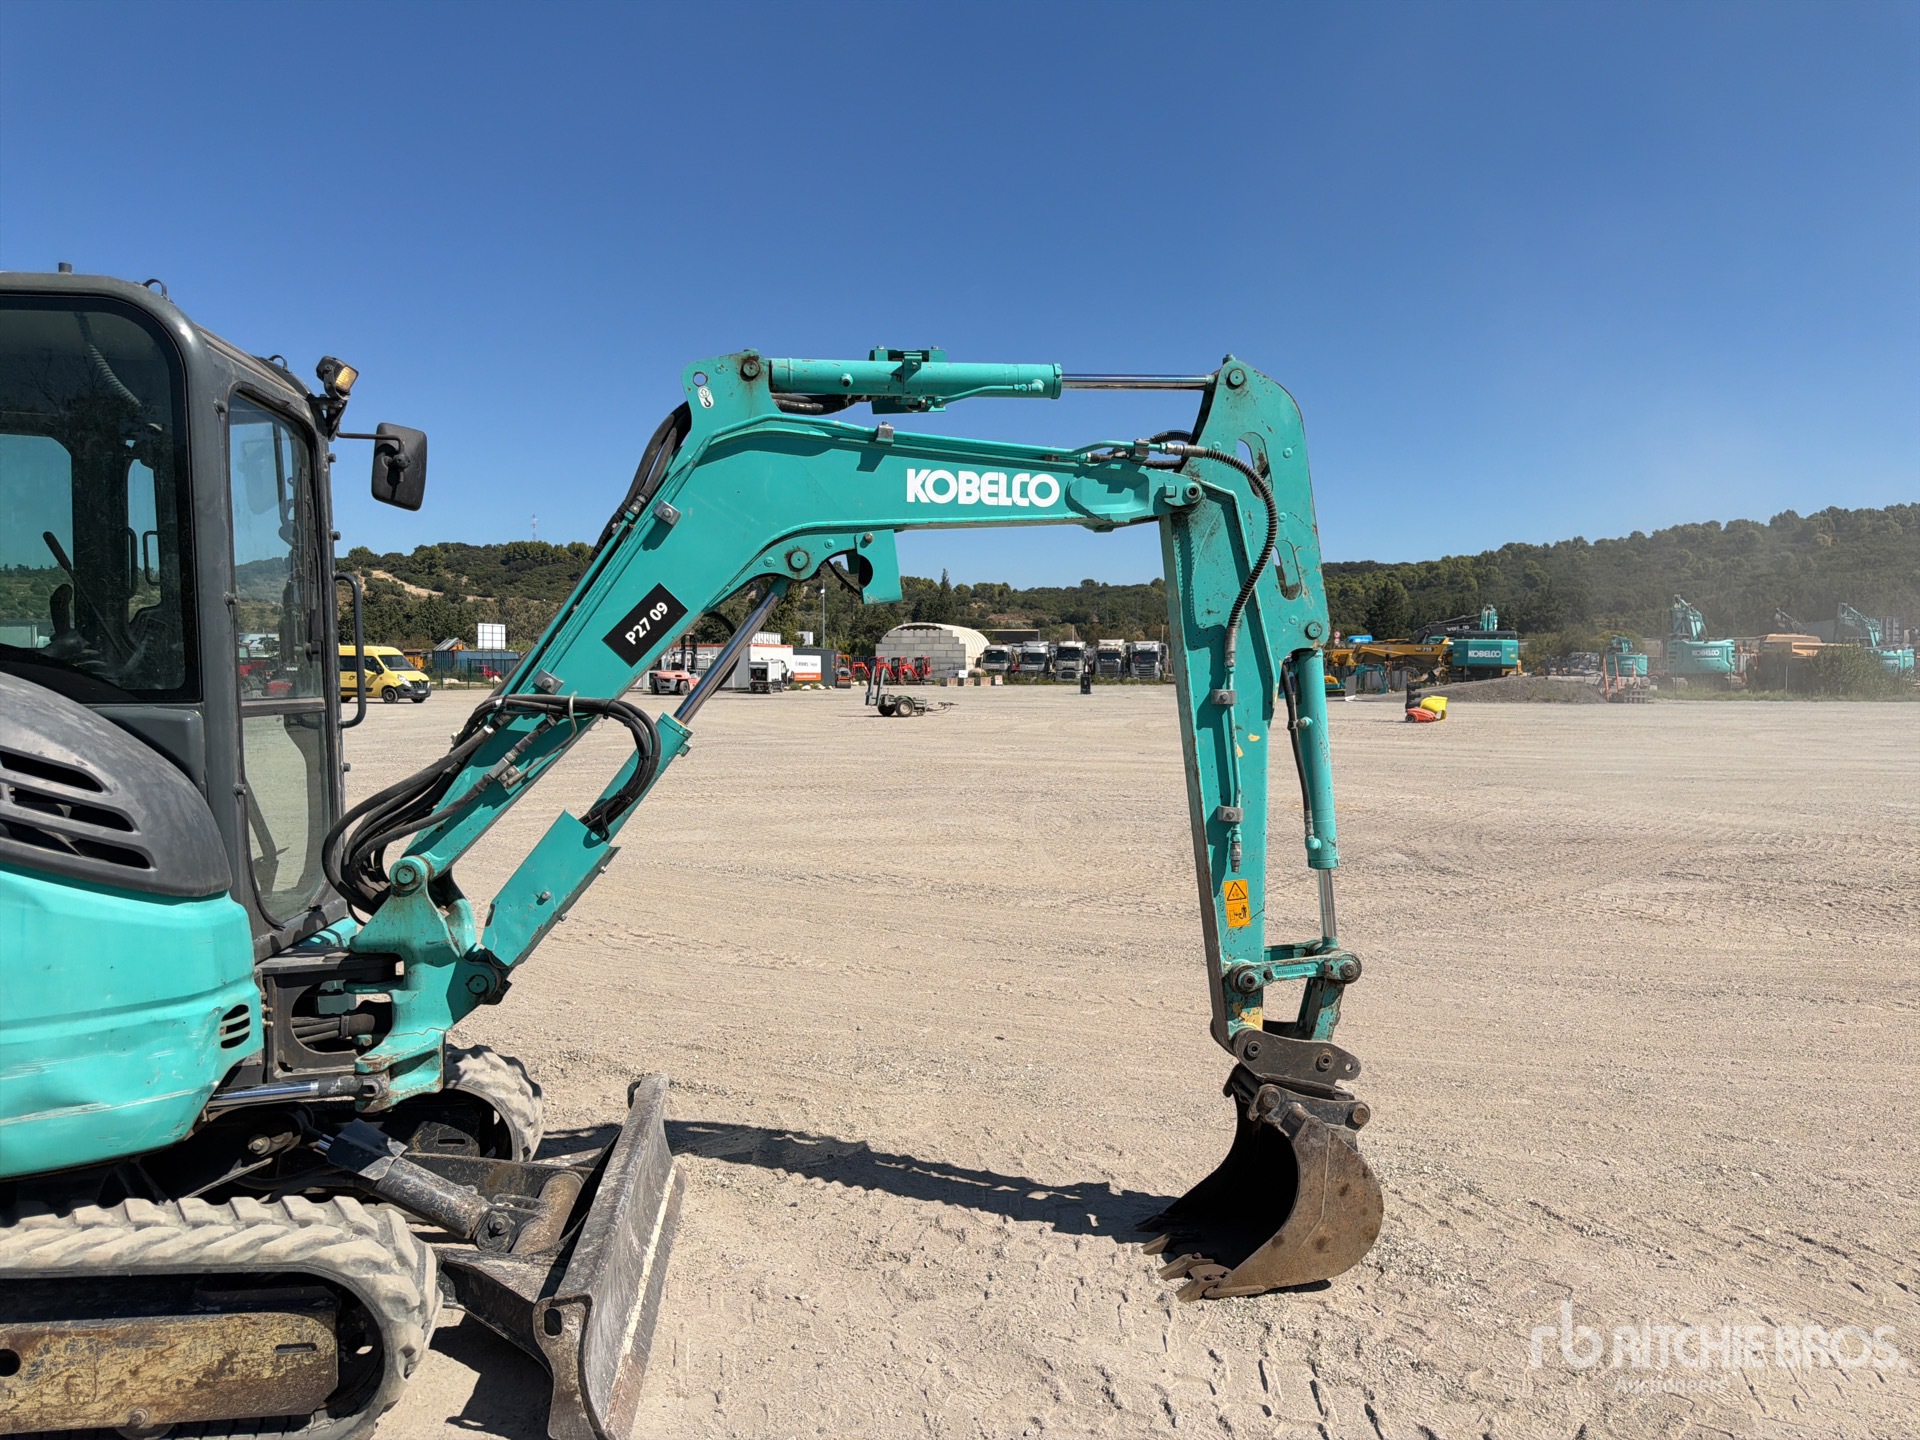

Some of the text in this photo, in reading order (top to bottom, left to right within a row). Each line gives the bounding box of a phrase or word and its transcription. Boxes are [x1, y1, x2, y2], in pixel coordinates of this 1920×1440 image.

[906, 468, 1060, 508] KOBELCO
[625, 601, 668, 645] P27 09
[1468, 650, 1501, 658] KOBELCO
